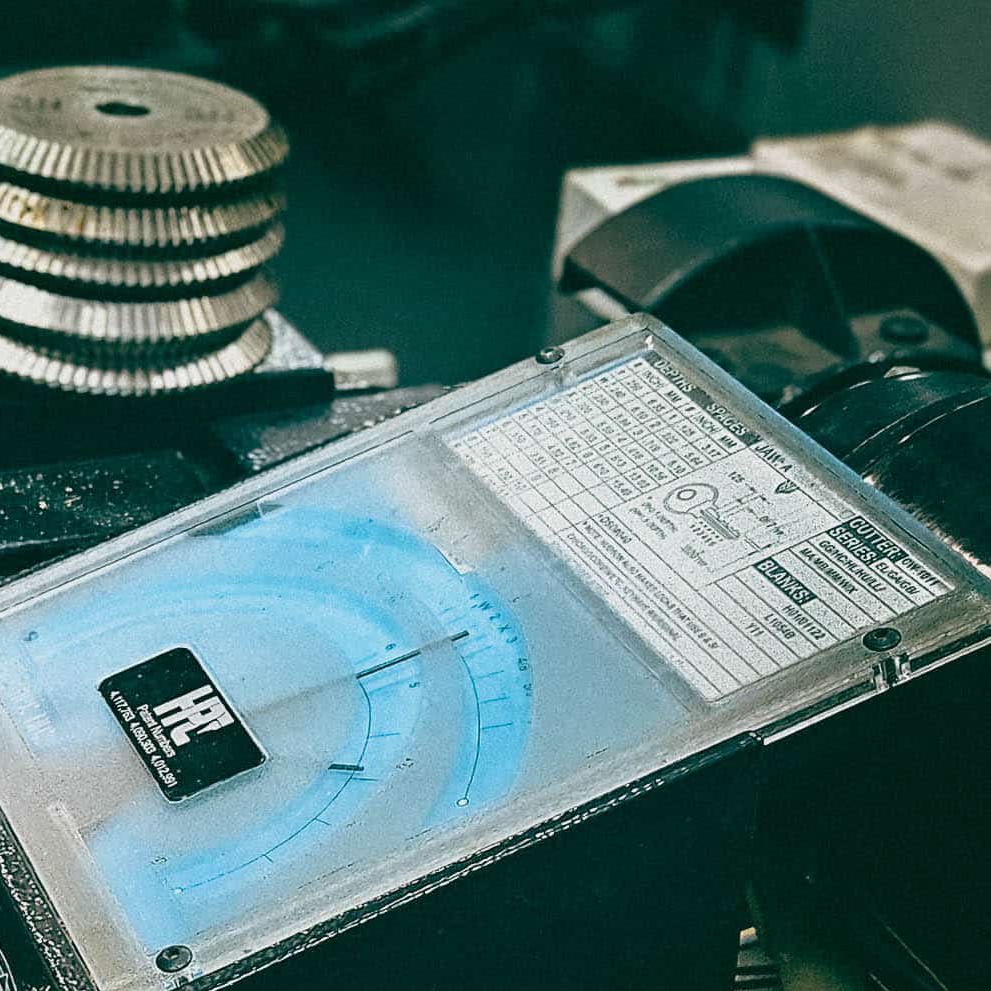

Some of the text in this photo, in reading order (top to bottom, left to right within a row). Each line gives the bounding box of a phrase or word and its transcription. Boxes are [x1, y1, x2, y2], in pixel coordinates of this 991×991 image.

[650, 359, 699, 392] DEPTHS
[703, 402, 751, 435] SPACES
[828, 526, 880, 564] SERIES:
[847, 518, 904, 559] CUTTER:
[756, 559, 813, 603] BLANKS:
[135, 703, 178, 758] Patent Numbers
